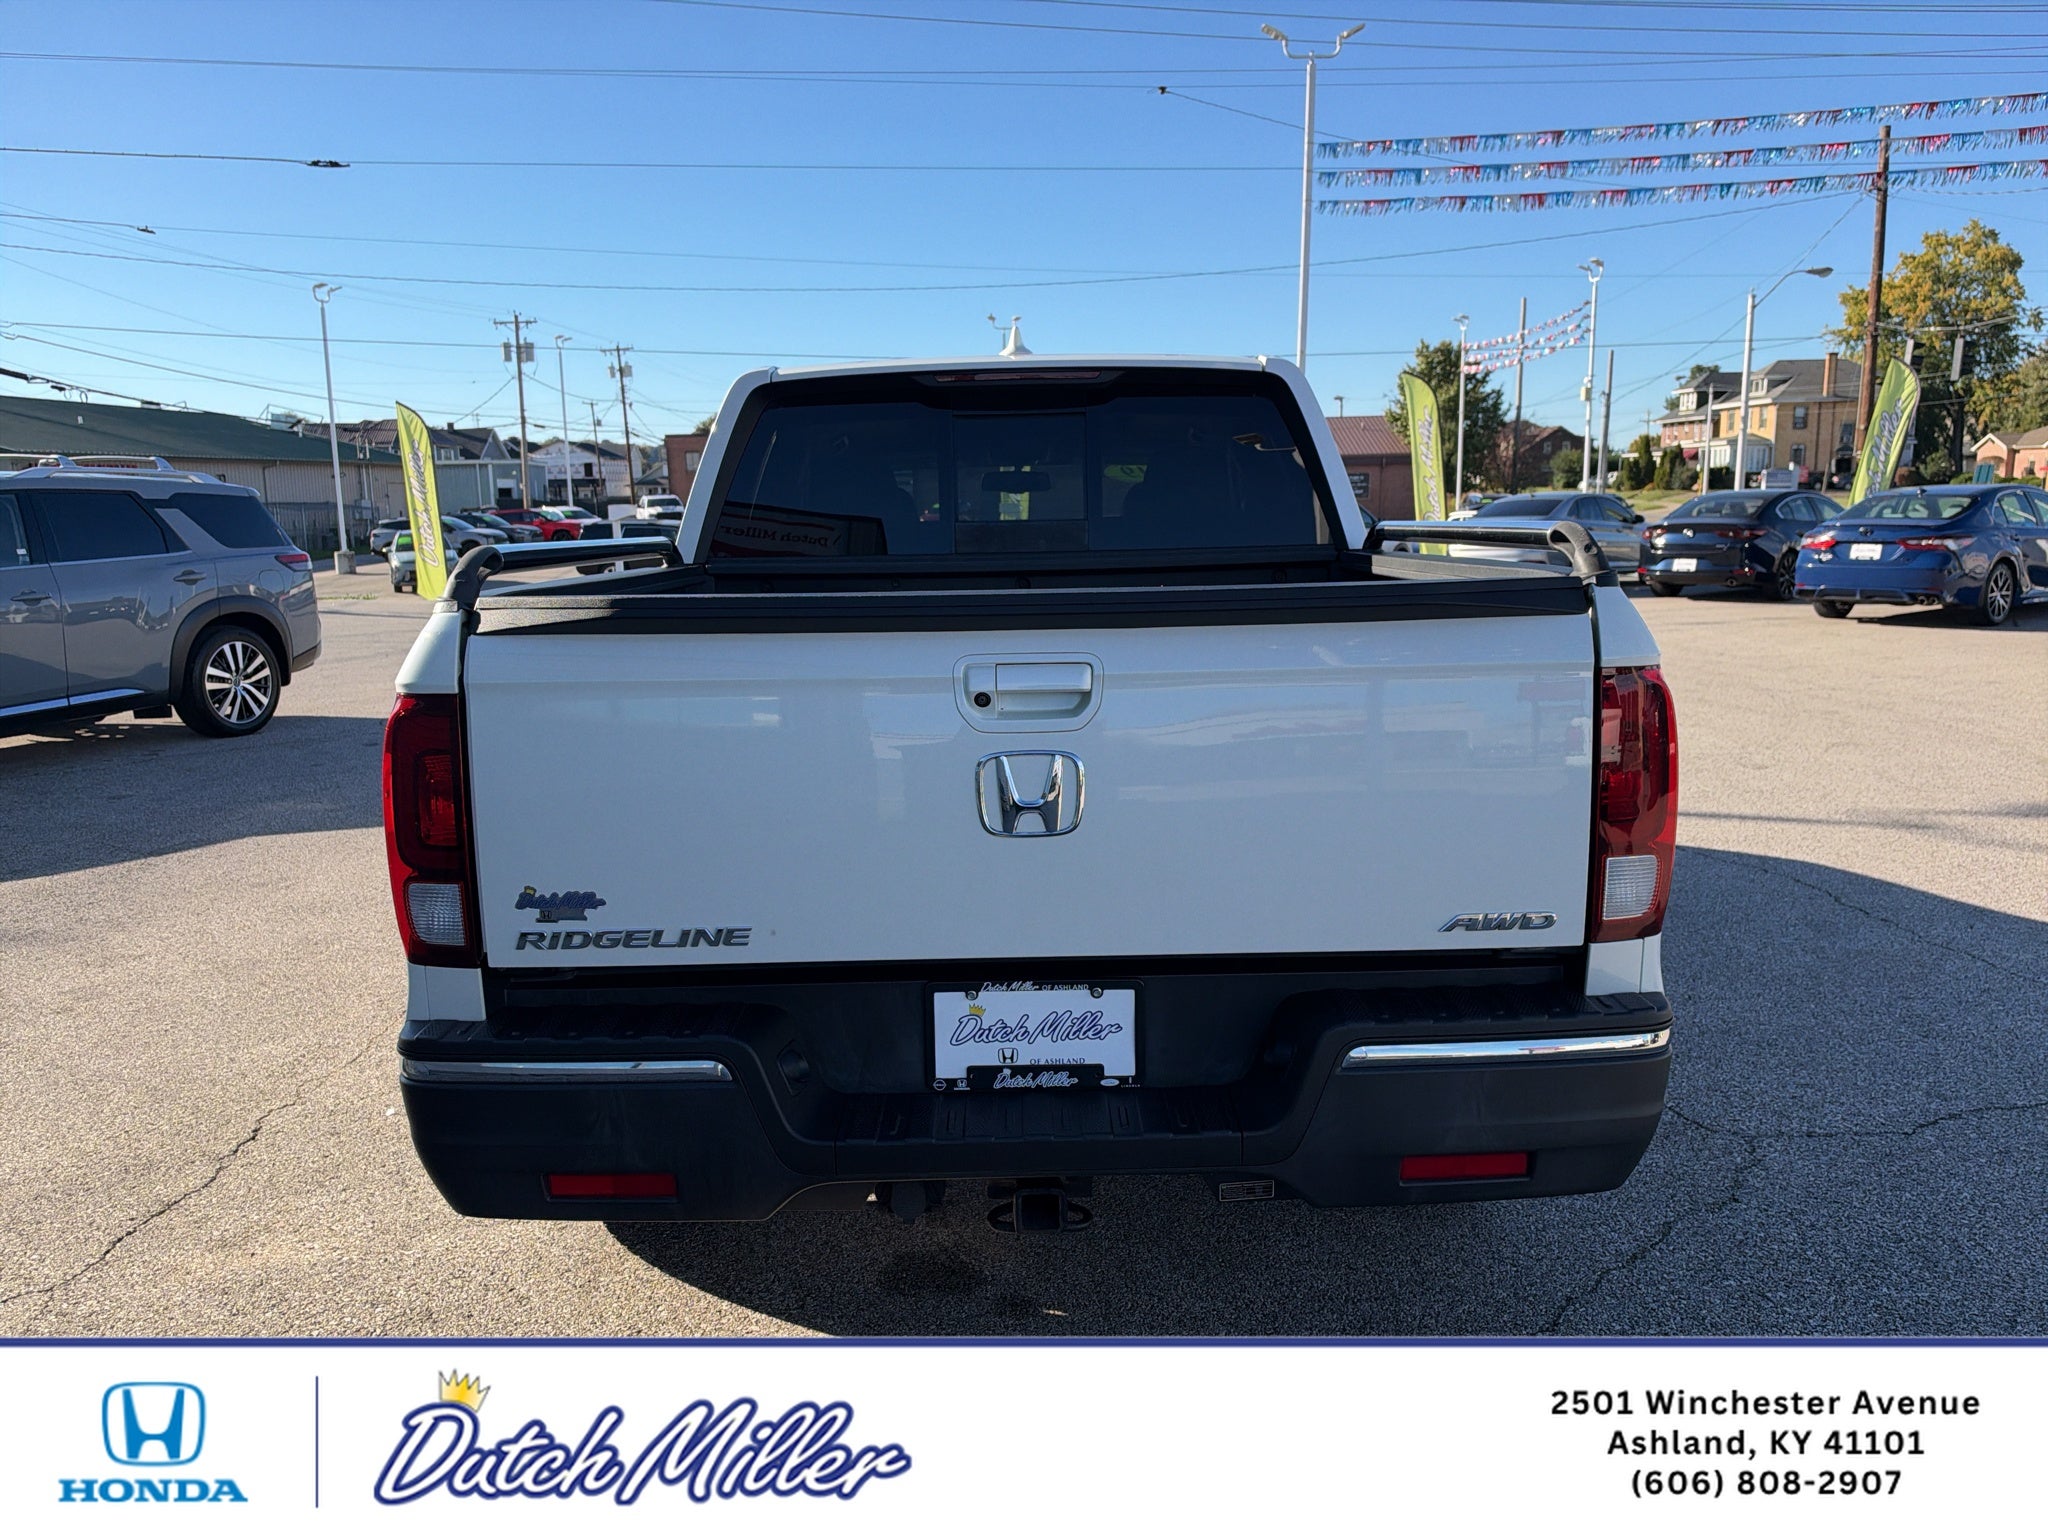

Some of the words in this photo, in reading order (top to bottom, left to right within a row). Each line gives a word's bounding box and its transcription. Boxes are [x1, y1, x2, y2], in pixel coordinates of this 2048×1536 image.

[1871, 399, 1902, 471] Miller
[408, 439, 431, 511] Miller
[415, 509, 439, 567] Dutch
[1437, 911, 1558, 932] AWD
[515, 927, 753, 950] RIDGELINE
[980, 981, 1009, 992] Dutch
[1007, 980, 1040, 992] Miller
[1041, 984, 1053, 992] OF
[1054, 983, 1089, 991] ASHLAND
[949, 1013, 1030, 1046] Dutch
[1028, 1010, 1123, 1044] Miller
[1043, 1057, 1086, 1065] ASHLAND
[993, 1072, 1035, 1089] Dutch
[1031, 1071, 1079, 1088] Miller
